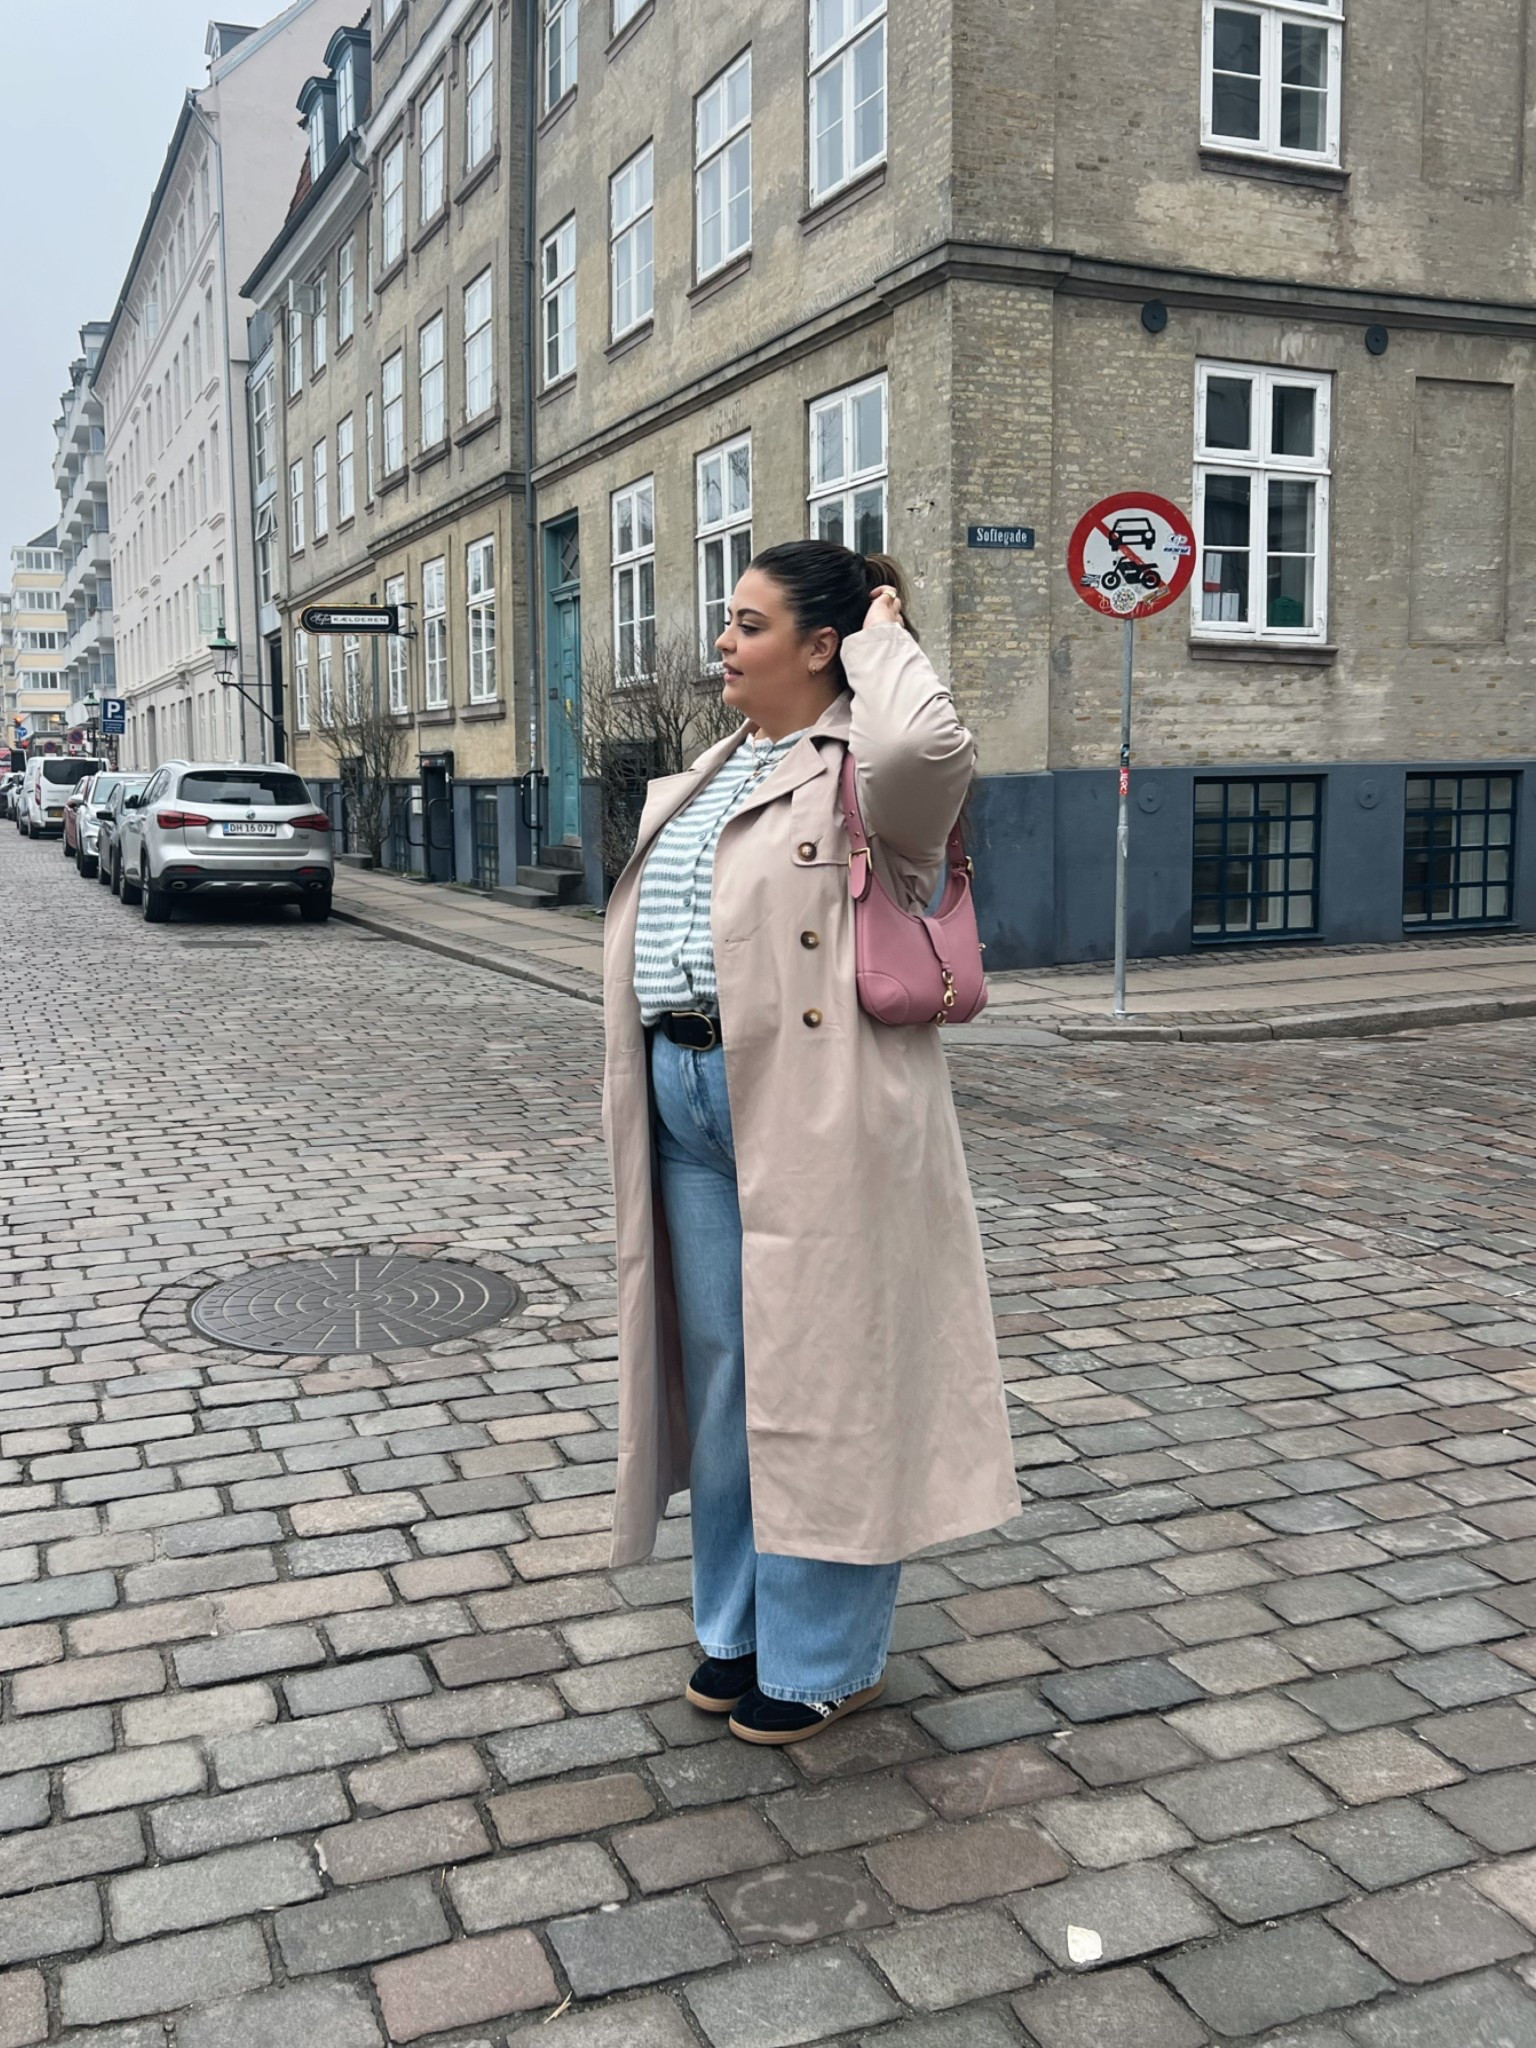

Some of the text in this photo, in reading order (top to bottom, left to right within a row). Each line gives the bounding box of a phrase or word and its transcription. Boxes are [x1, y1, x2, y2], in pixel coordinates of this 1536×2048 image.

[976, 527, 1028, 546] Sofiegade
[107, 700, 121, 719] P
[230, 823, 274, 833] DH 16 077
